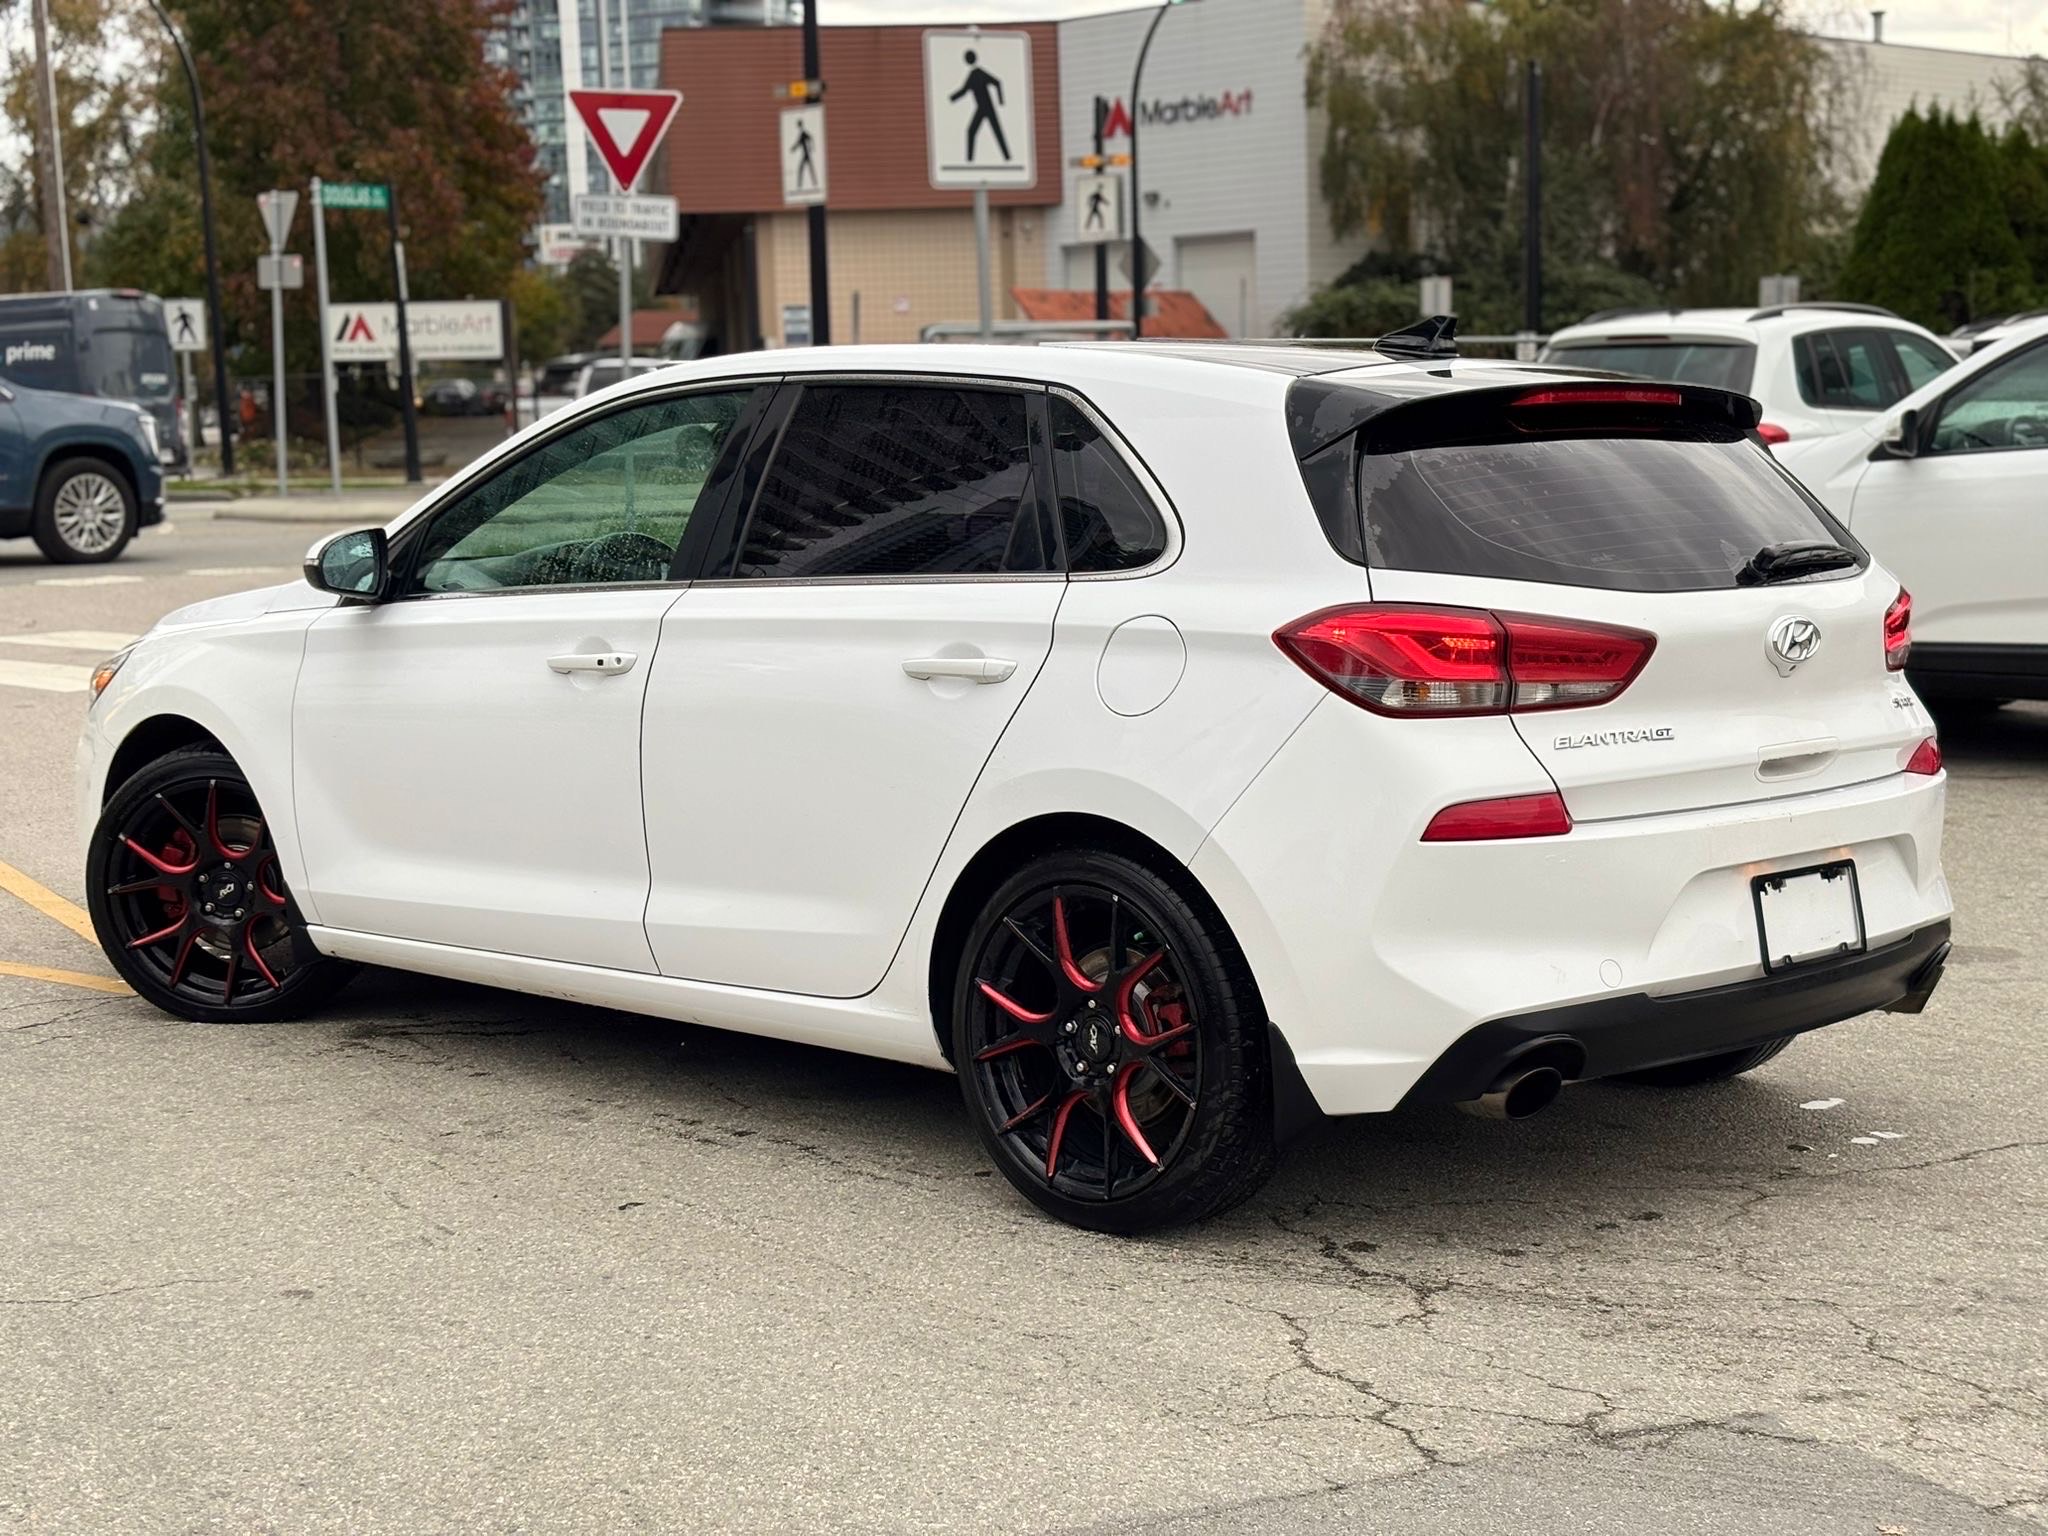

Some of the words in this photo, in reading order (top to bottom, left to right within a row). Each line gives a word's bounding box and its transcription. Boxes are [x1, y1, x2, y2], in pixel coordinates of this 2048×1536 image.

[1141, 89, 1252, 125] MarbleArt
[6, 340, 56, 367] prime
[1553, 728, 1653, 751] ELANTRA
[1655, 727, 1674, 738] GT
